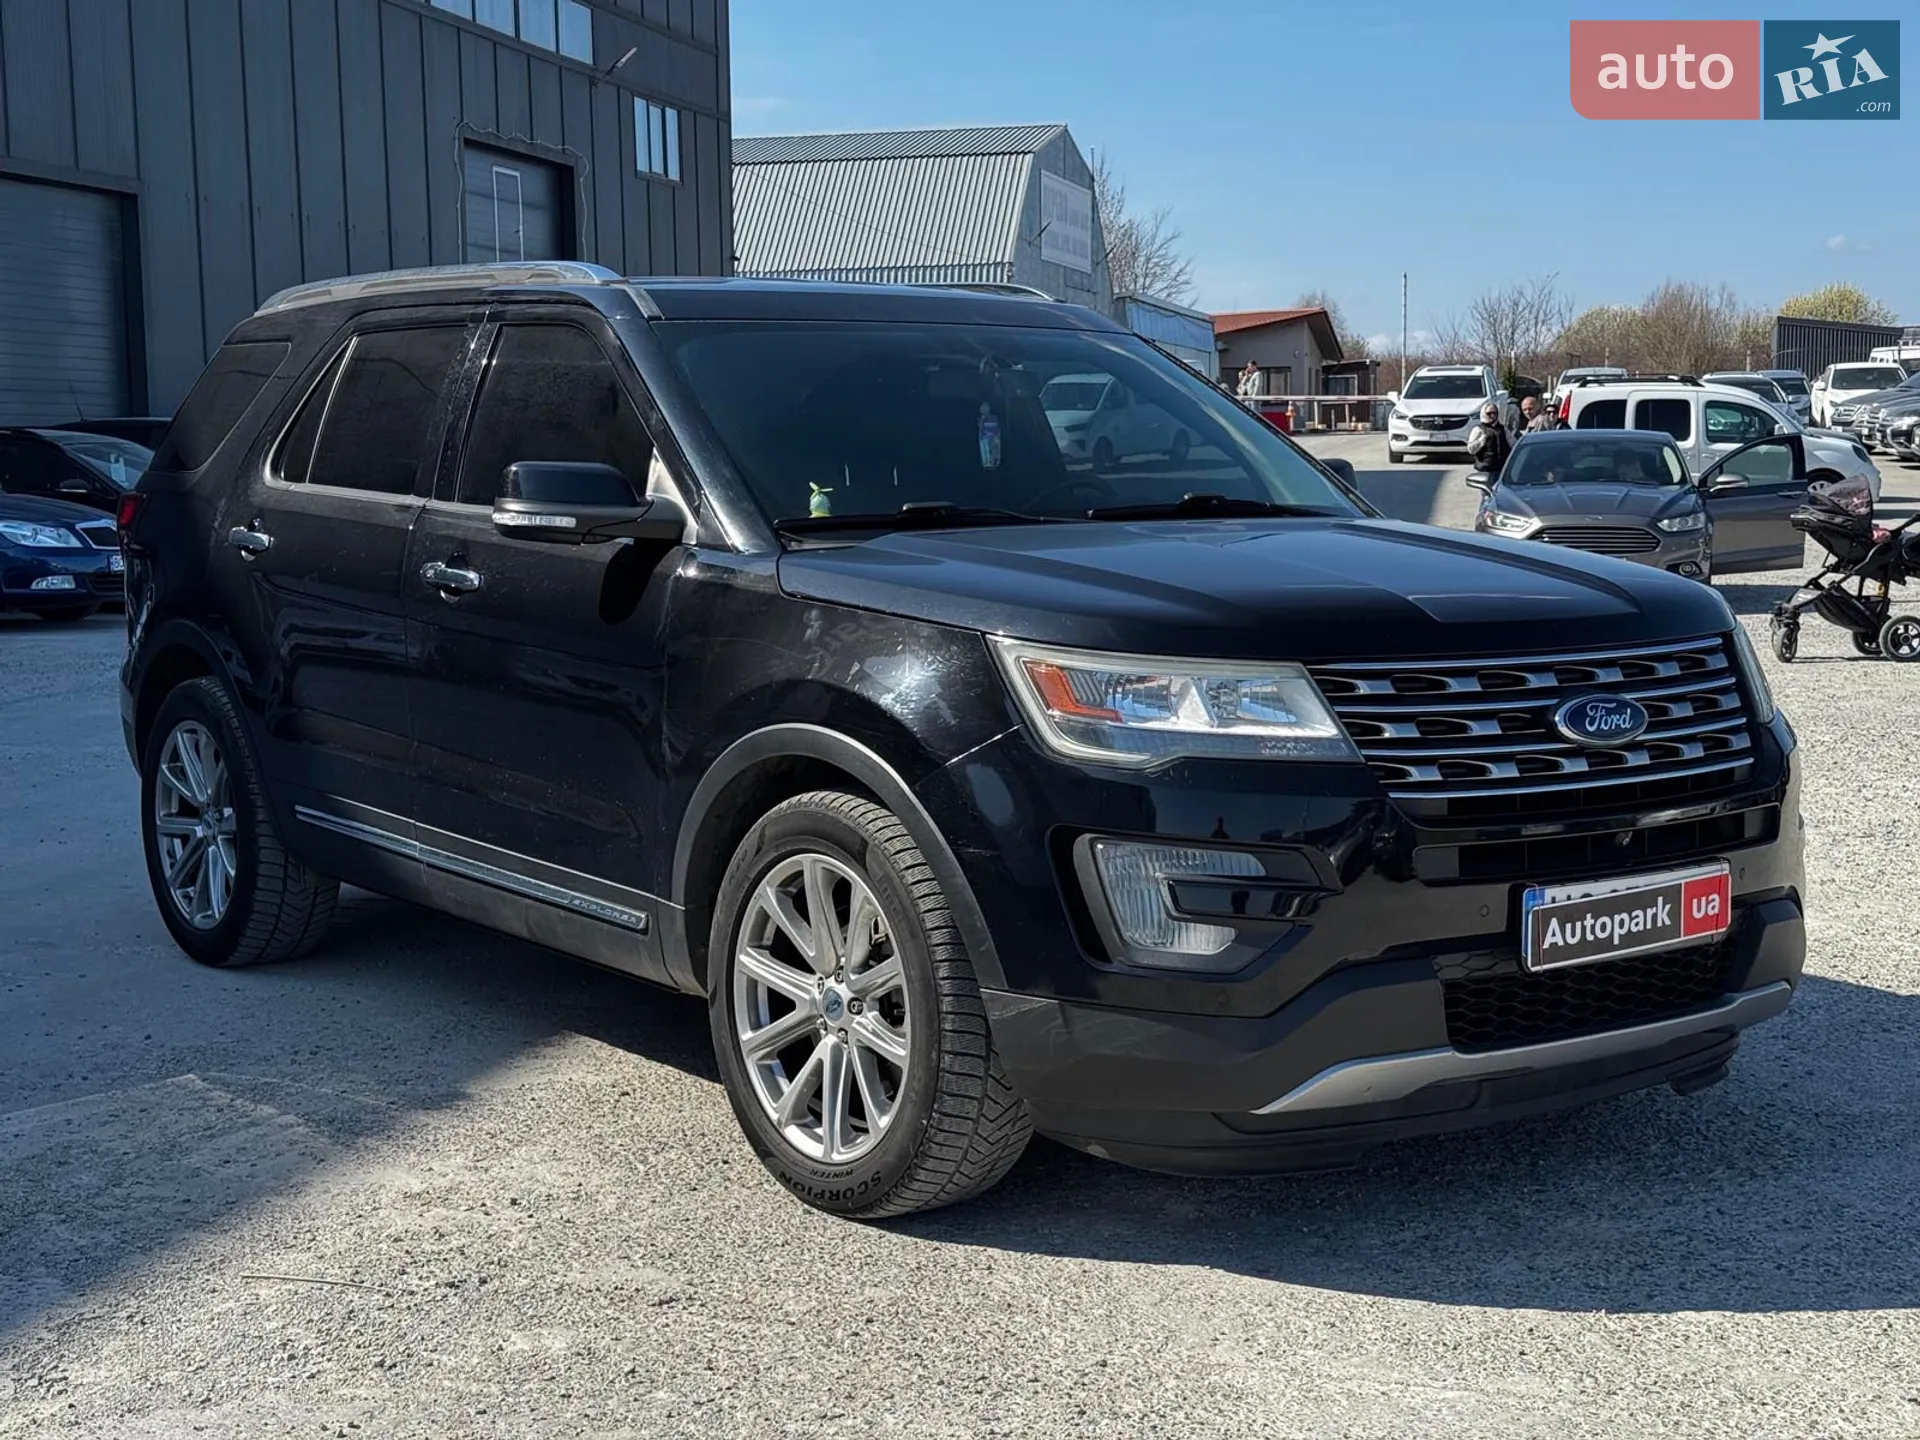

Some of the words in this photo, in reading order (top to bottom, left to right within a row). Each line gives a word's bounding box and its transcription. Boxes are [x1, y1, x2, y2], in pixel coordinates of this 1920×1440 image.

[1585, 702, 1633, 732] Ford
[1542, 896, 1672, 945] Autopark
[1691, 893, 1720, 919] ua
[779, 1170, 882, 1202] SCORPION
[809, 1168, 855, 1180] WINTER
